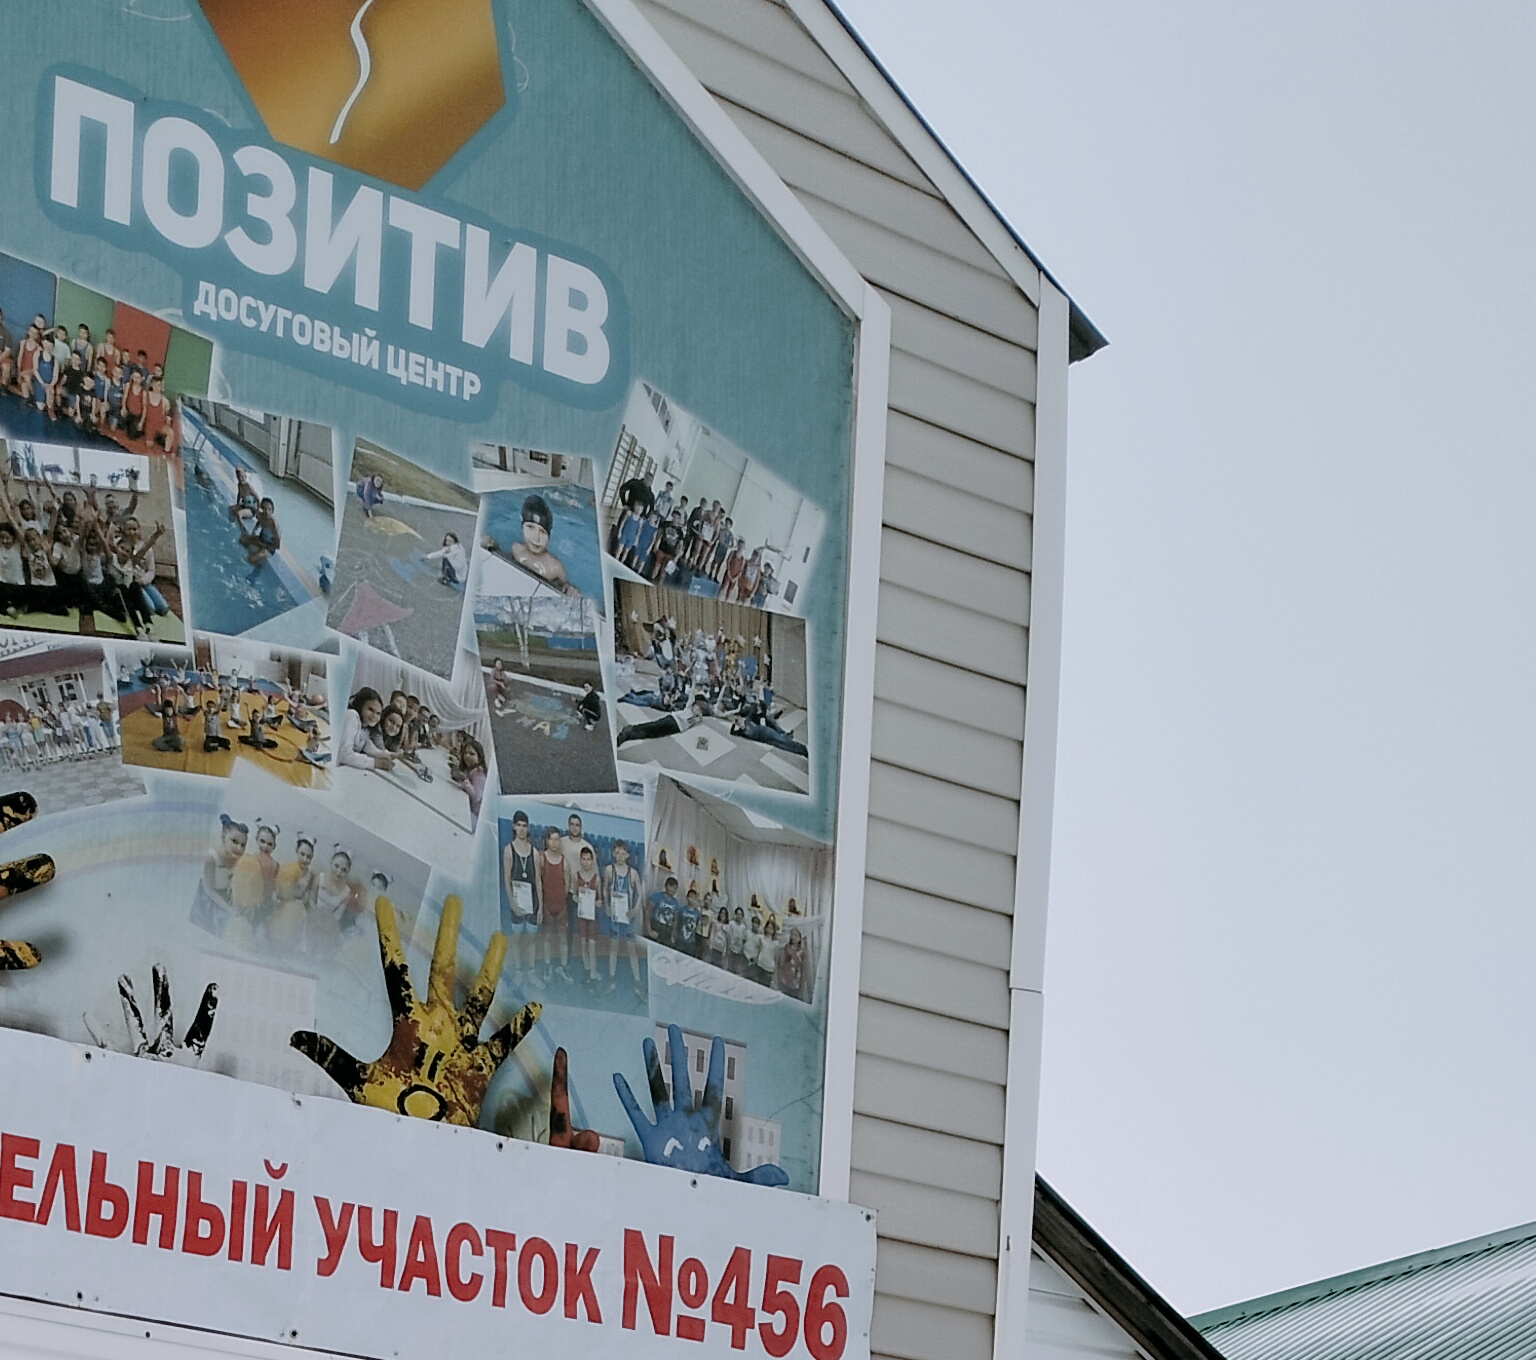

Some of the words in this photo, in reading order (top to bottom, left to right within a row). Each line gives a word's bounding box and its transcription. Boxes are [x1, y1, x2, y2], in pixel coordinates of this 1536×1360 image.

[51, 75, 611, 386] ПОЗИТИВ
[194, 279, 379, 368] ДОСУГОВЫЙ
[386, 345, 482, 401] ЦЕНТР
[313, 1195, 603, 1324] УЧАСТОК
